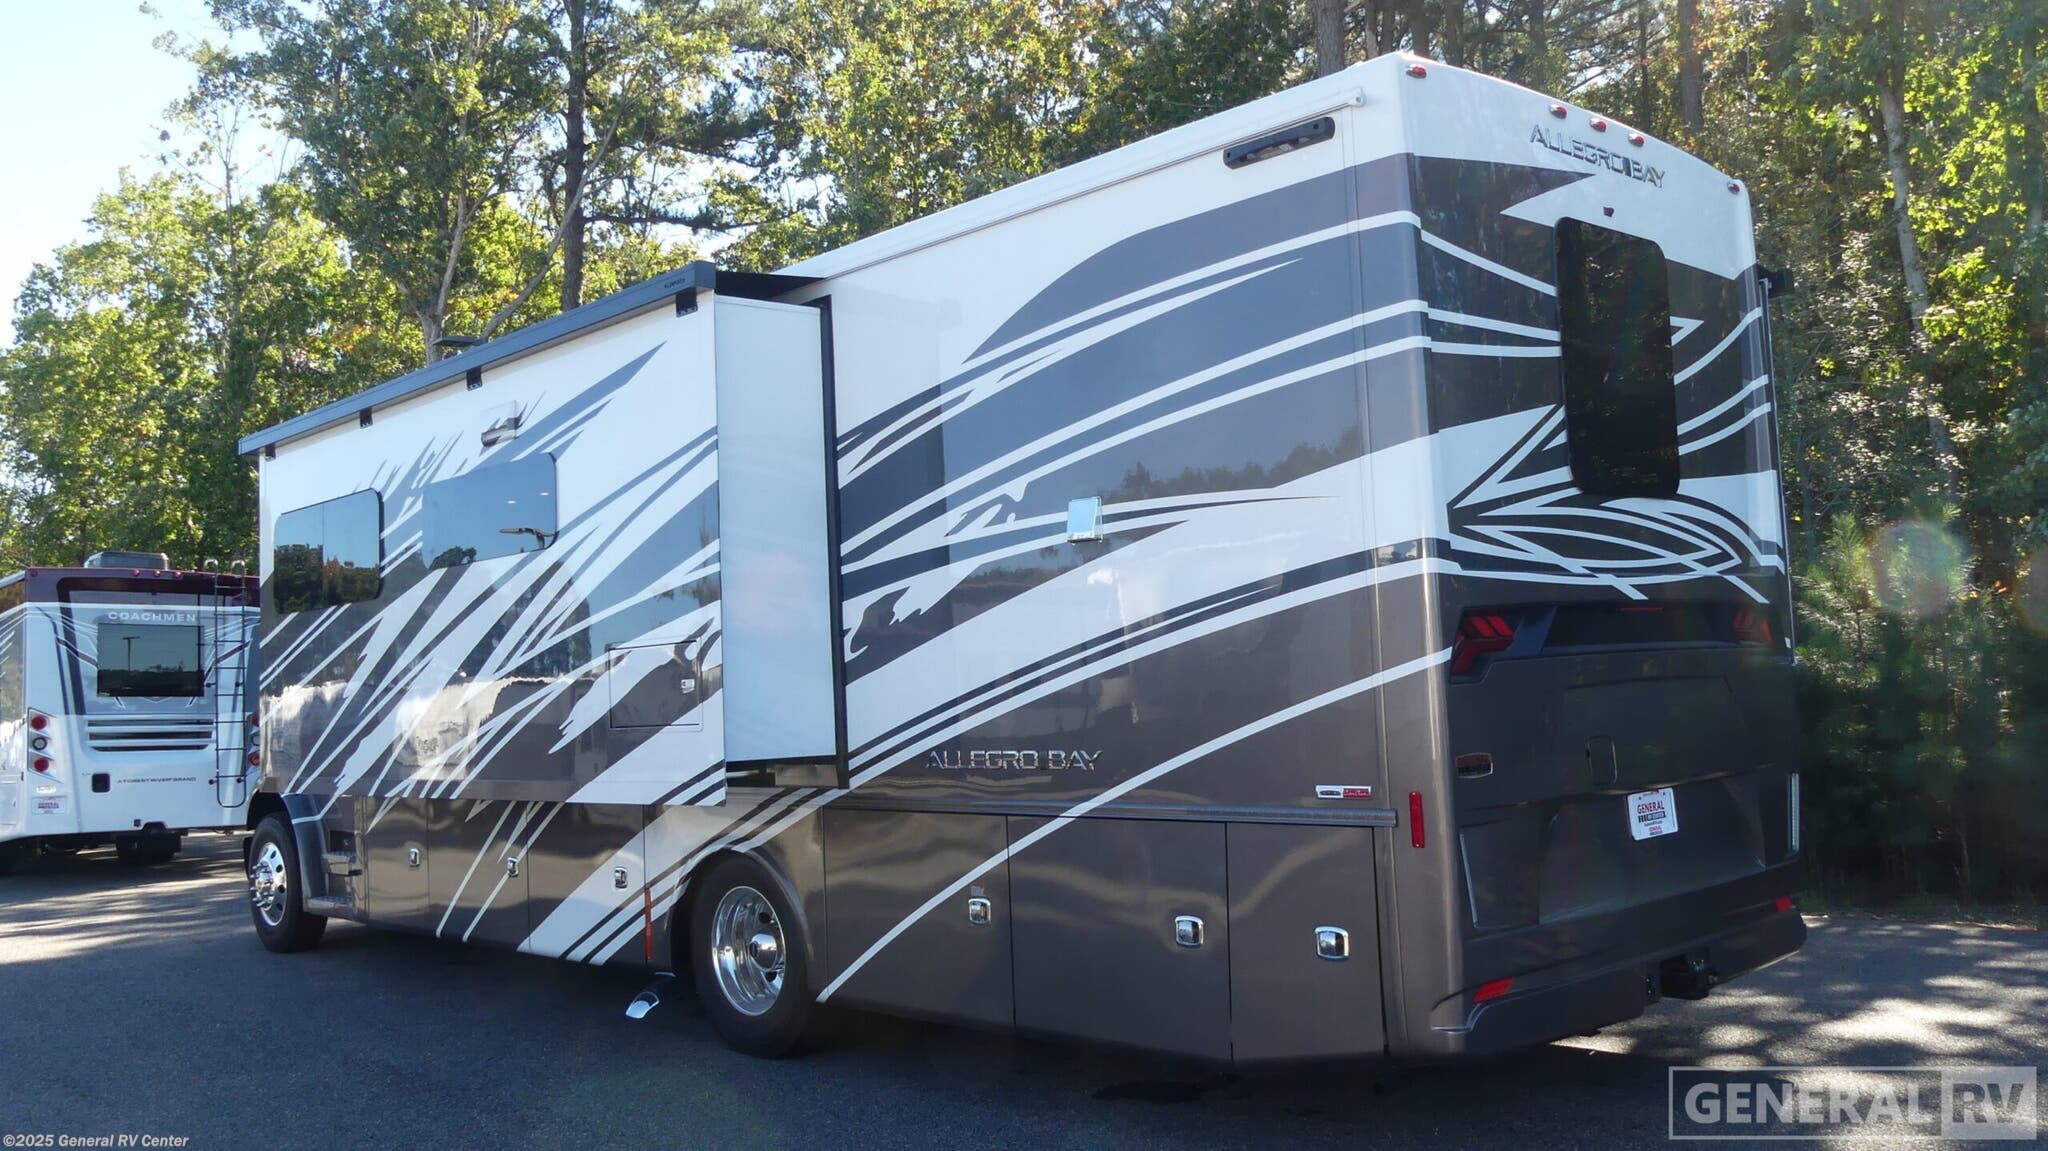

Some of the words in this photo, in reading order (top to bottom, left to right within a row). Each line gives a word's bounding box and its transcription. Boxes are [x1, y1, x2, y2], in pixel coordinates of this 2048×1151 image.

[1530, 124, 1624, 175] ALLEGRO
[1631, 160, 1666, 188] BAY
[108, 611, 196, 622] COACHMEN
[926, 750, 1038, 770] ALLEGRO
[1048, 750, 1102, 771] BAY
[1637, 801, 1664, 814] GENERAL
